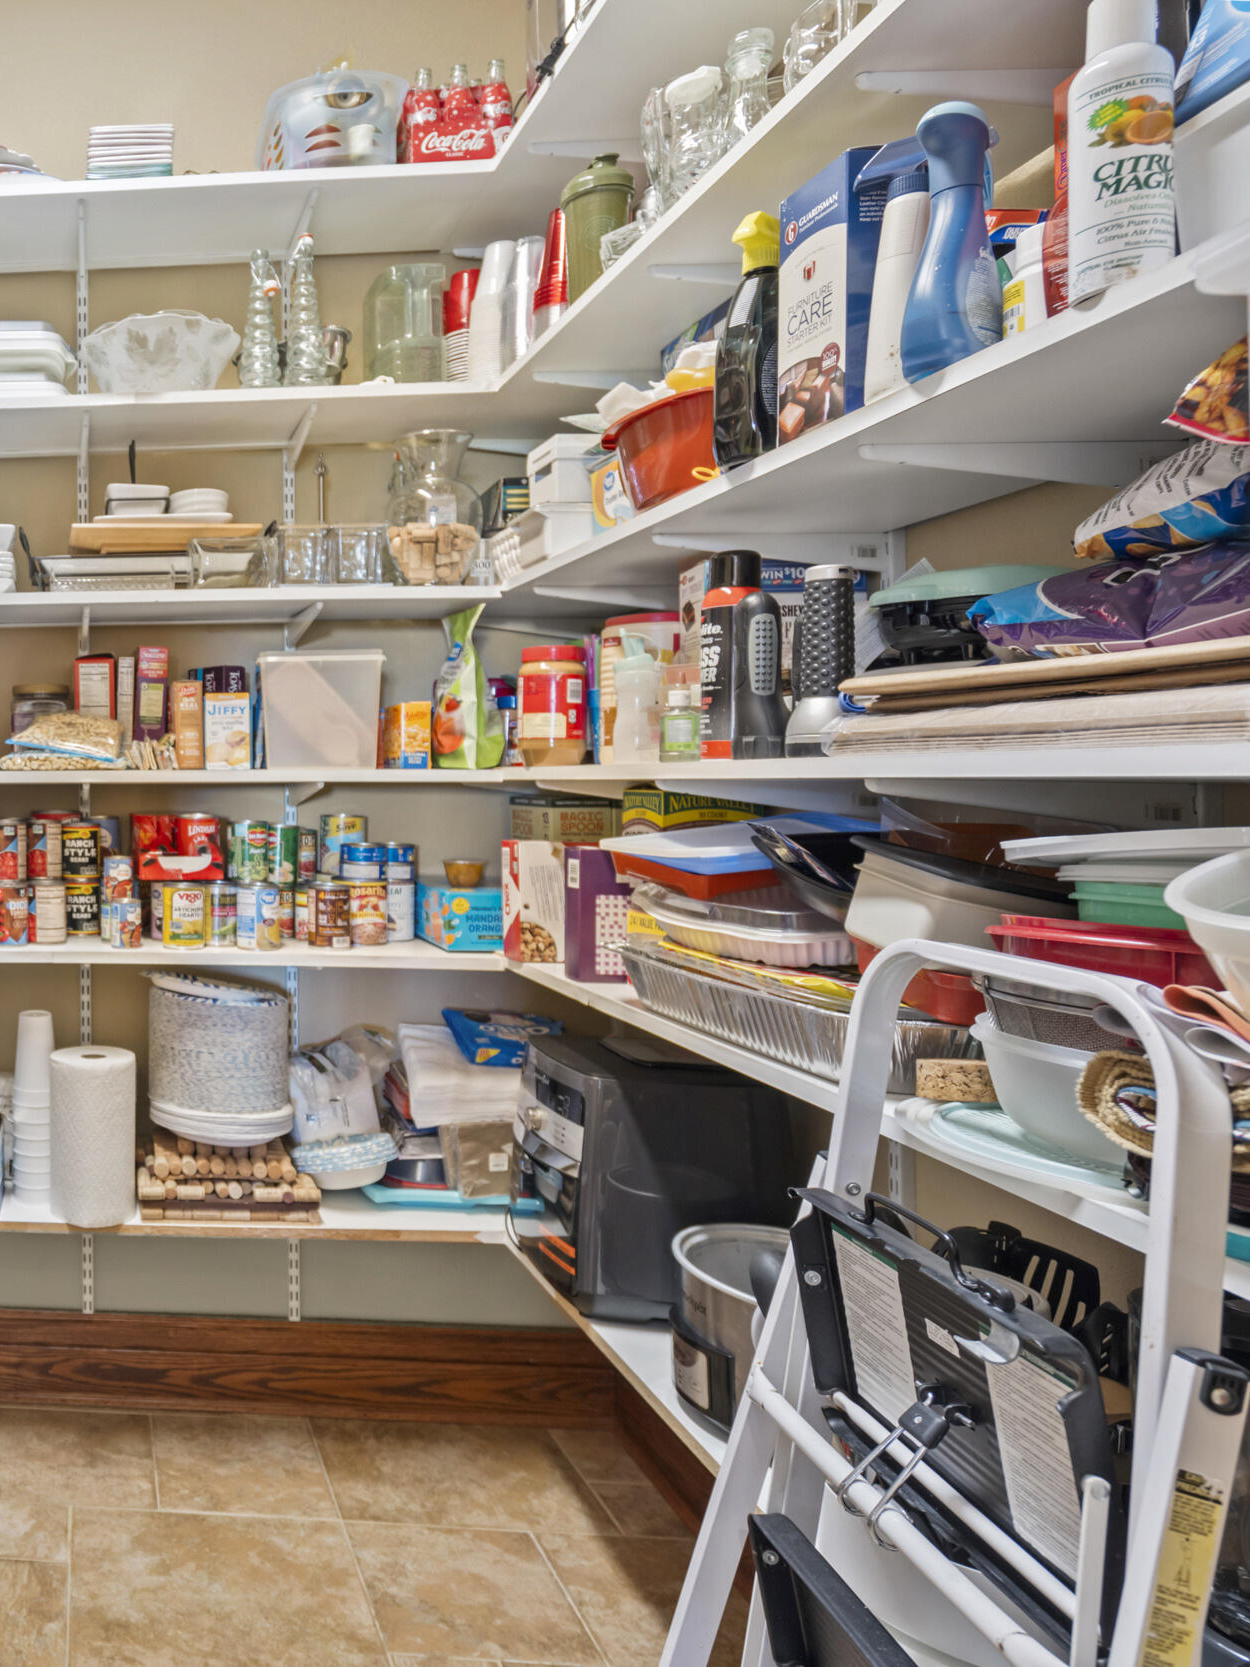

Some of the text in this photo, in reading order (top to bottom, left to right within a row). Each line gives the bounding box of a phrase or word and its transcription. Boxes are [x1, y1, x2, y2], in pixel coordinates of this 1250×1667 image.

[1089, 80, 1137, 100] TROPICAL
[421, 128, 488, 154] Coca-Cola
[1092, 154, 1174, 183] CITRU
[798, 191, 839, 227] GUARDSMAN
[1097, 229, 1147, 244] Citrus Air
[787, 281, 833, 316] FURNITURE
[787, 292, 833, 336] CARE
[787, 314, 832, 348] STARTER KIT
[207, 704, 246, 716] JIFFY
[560, 811, 602, 821] MAGIC
[561, 821, 605, 833] SPOON
[64, 848, 97, 857] STYLE
[466, 914, 503, 923] MANDA
[469, 924, 503, 933] ORANG
